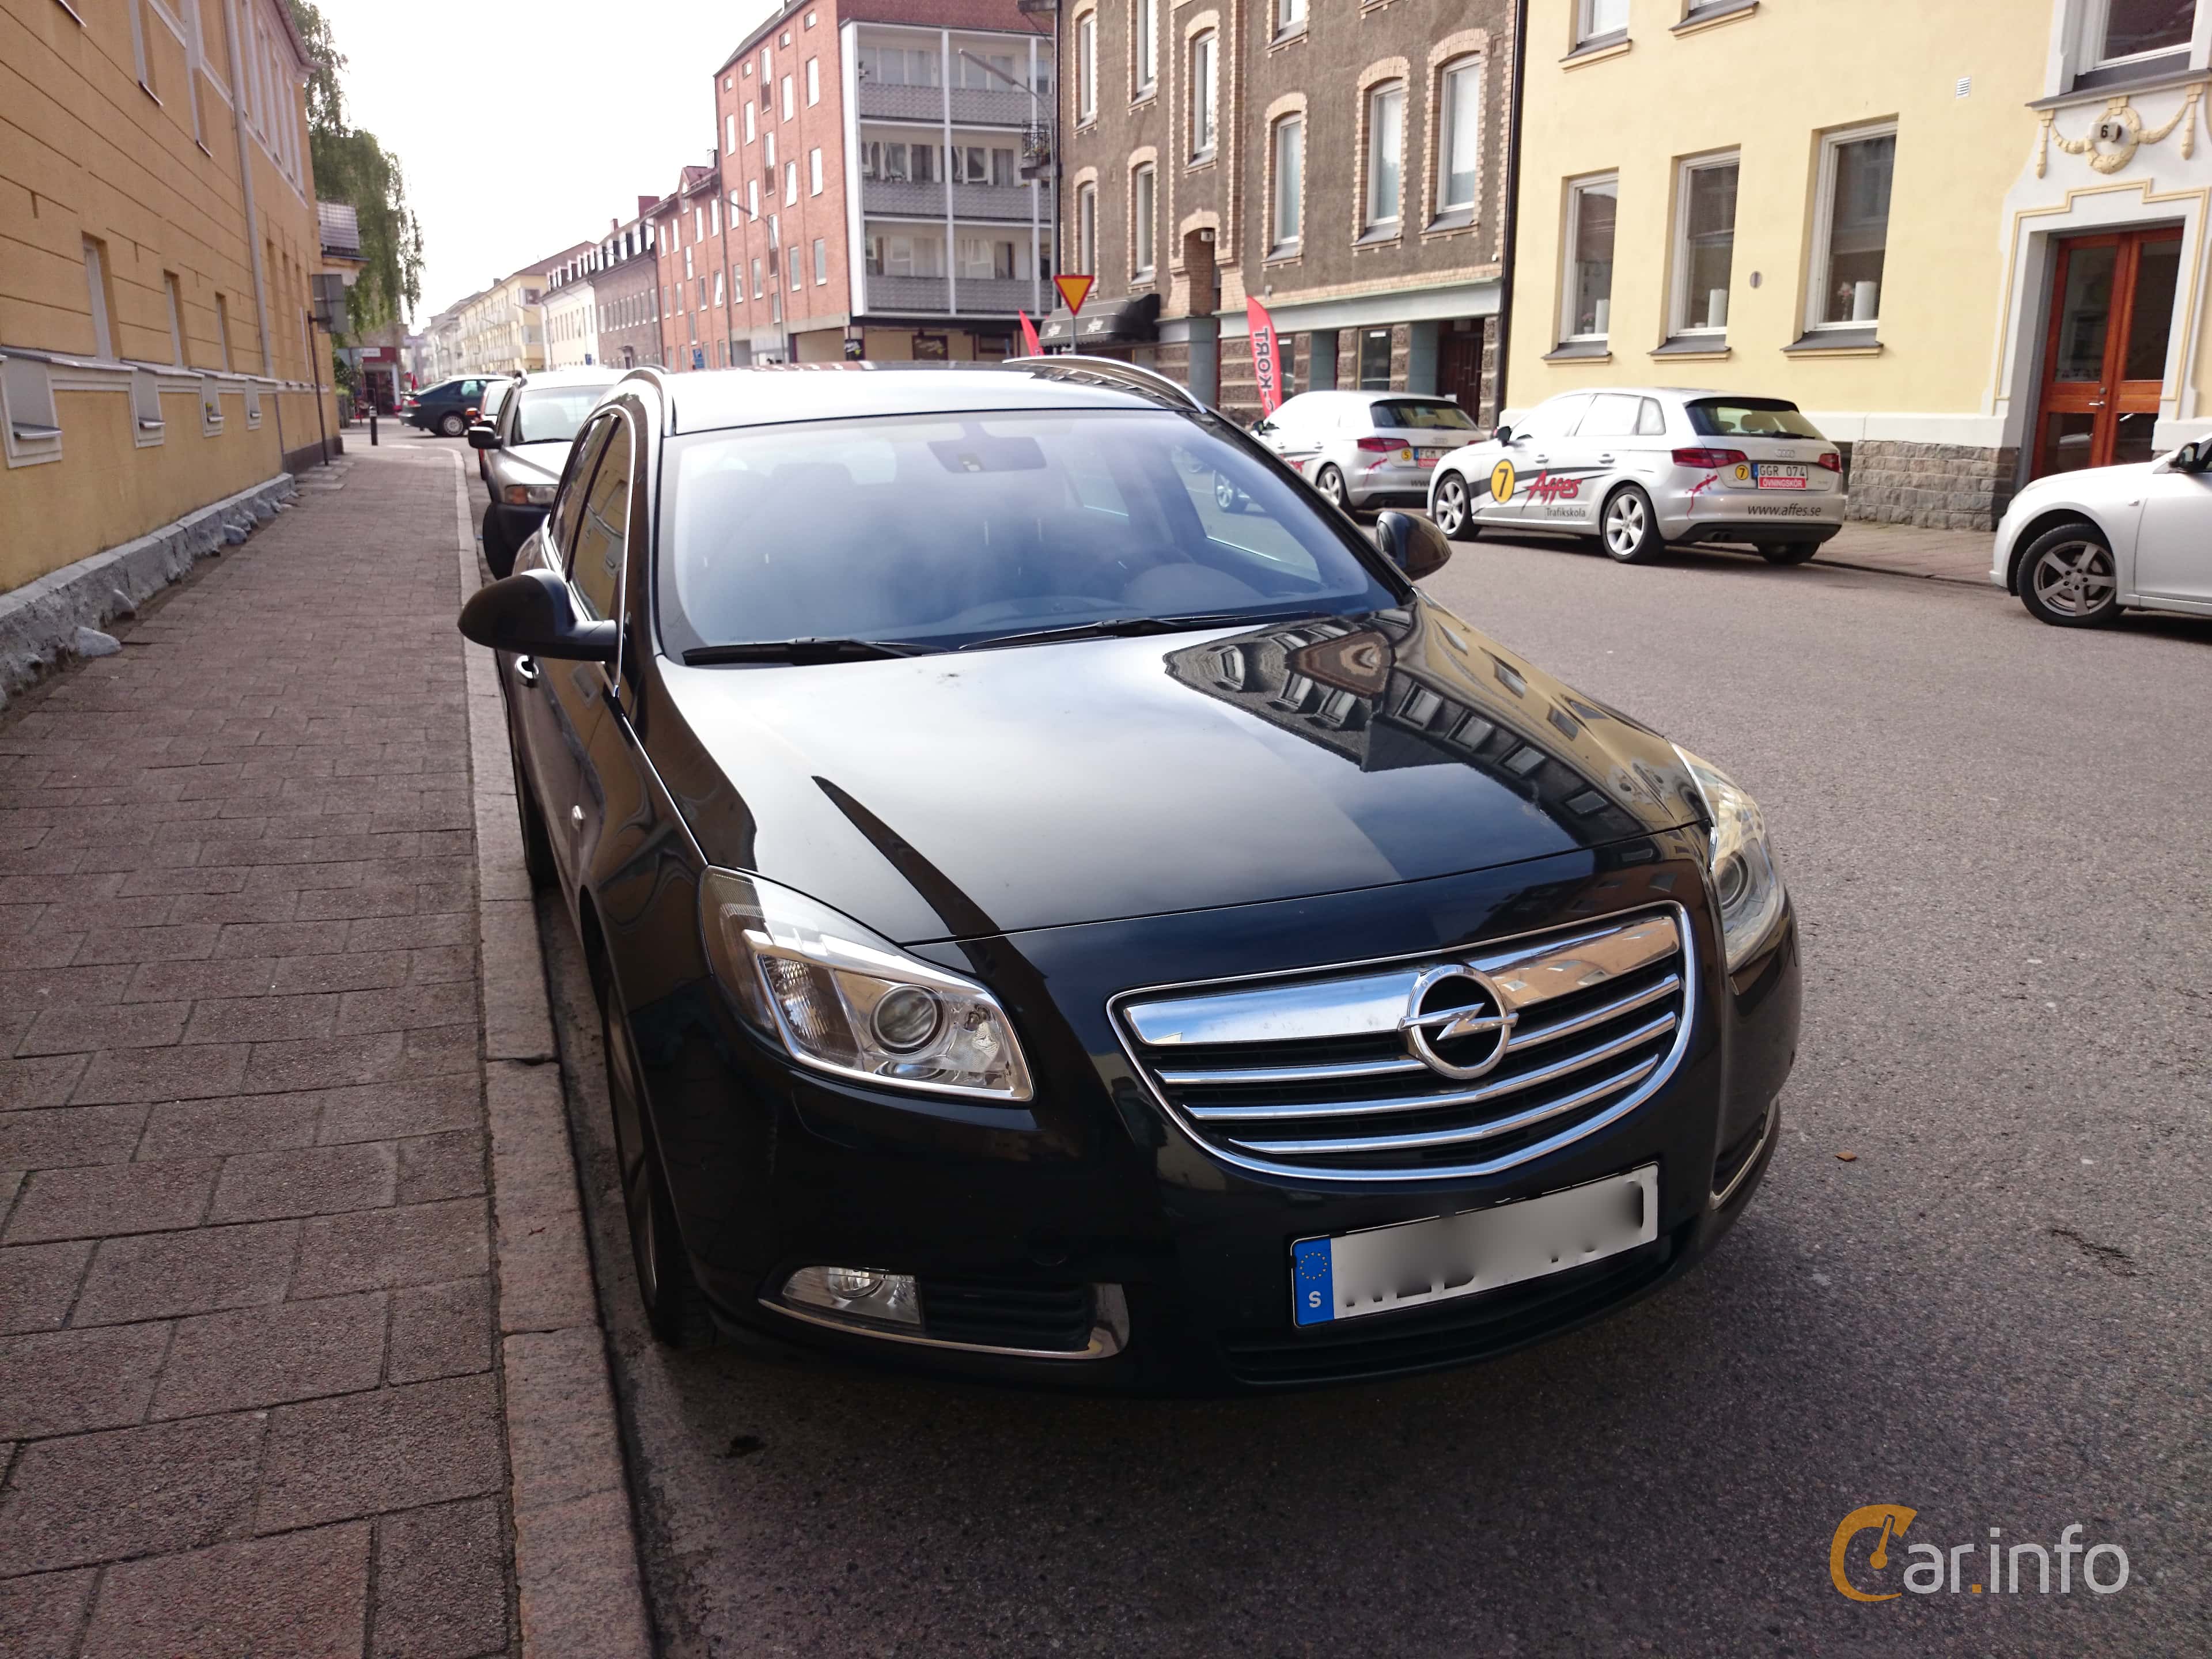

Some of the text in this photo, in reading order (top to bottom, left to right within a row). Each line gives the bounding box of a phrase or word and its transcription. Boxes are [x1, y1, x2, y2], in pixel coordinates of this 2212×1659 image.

[2101, 124, 2108, 139] 6
[1739, 468, 1745, 478] 7
[1759, 465, 1805, 476] GGR 074
[1498, 468, 1509, 498] 7
[1523, 469, 1583, 505] Affes
[1762, 479, 1803, 487] ÖVNINGSKÖR
[1546, 507, 1586, 517] Trafikskola
[1748, 503, 1821, 517] www.affes.se
[1308, 1291, 1321, 1308] S
